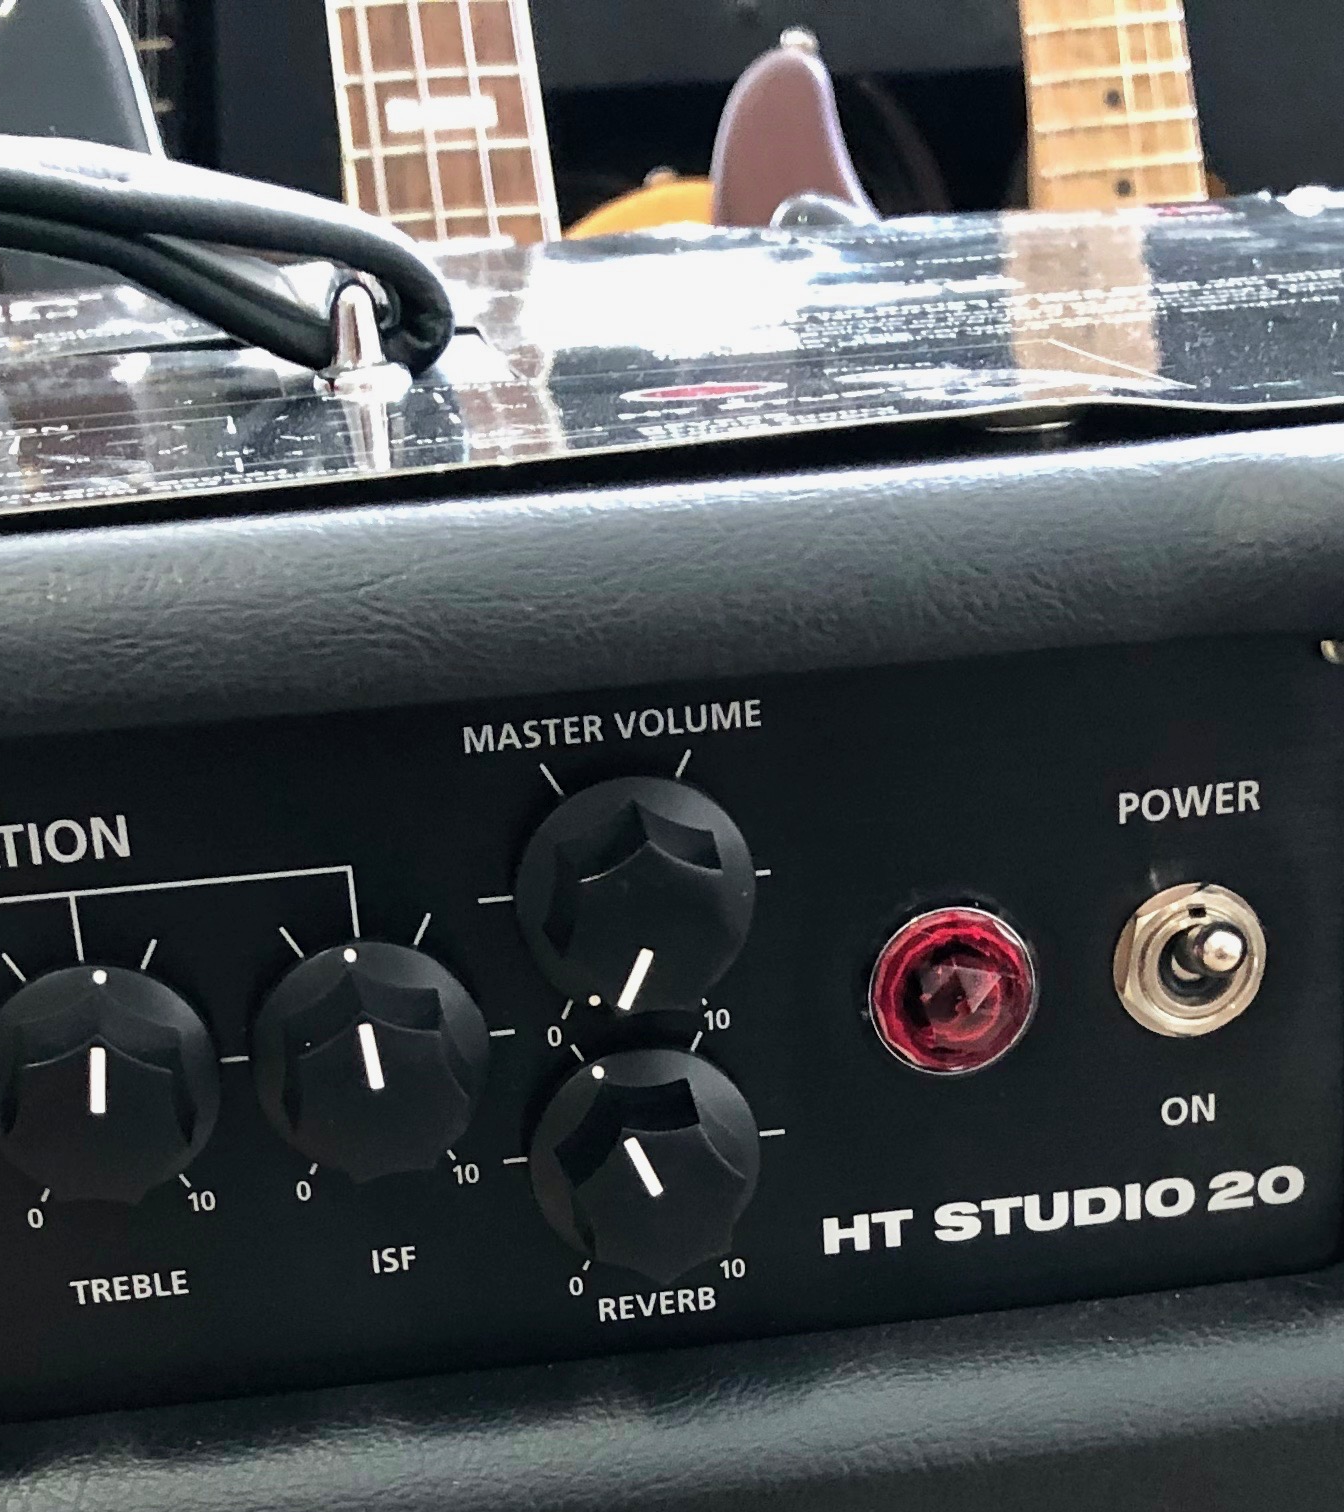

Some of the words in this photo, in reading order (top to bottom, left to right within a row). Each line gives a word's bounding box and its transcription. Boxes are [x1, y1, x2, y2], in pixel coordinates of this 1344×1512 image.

[462, 714, 604, 754] MASTER
[613, 699, 762, 739] VOLUME
[1118, 780, 1261, 825] POWER
[704, 1008, 731, 1031] 10
[547, 1025, 562, 1047] 0
[1160, 1093, 1216, 1126] ON
[453, 1163, 480, 1185] 10
[187, 1190, 216, 1212] 10
[296, 1180, 312, 1202] 0
[27, 1208, 44, 1229] 0
[822, 1208, 914, 1255] HT
[934, 1177, 1196, 1242] STUDIO
[1207, 1165, 1305, 1212] 20
[371, 1245, 416, 1274] ISF
[719, 1258, 746, 1279] 10
[69, 1269, 190, 1305] TREBLE
[568, 1276, 584, 1296] 0
[598, 1286, 716, 1323] REVERB
